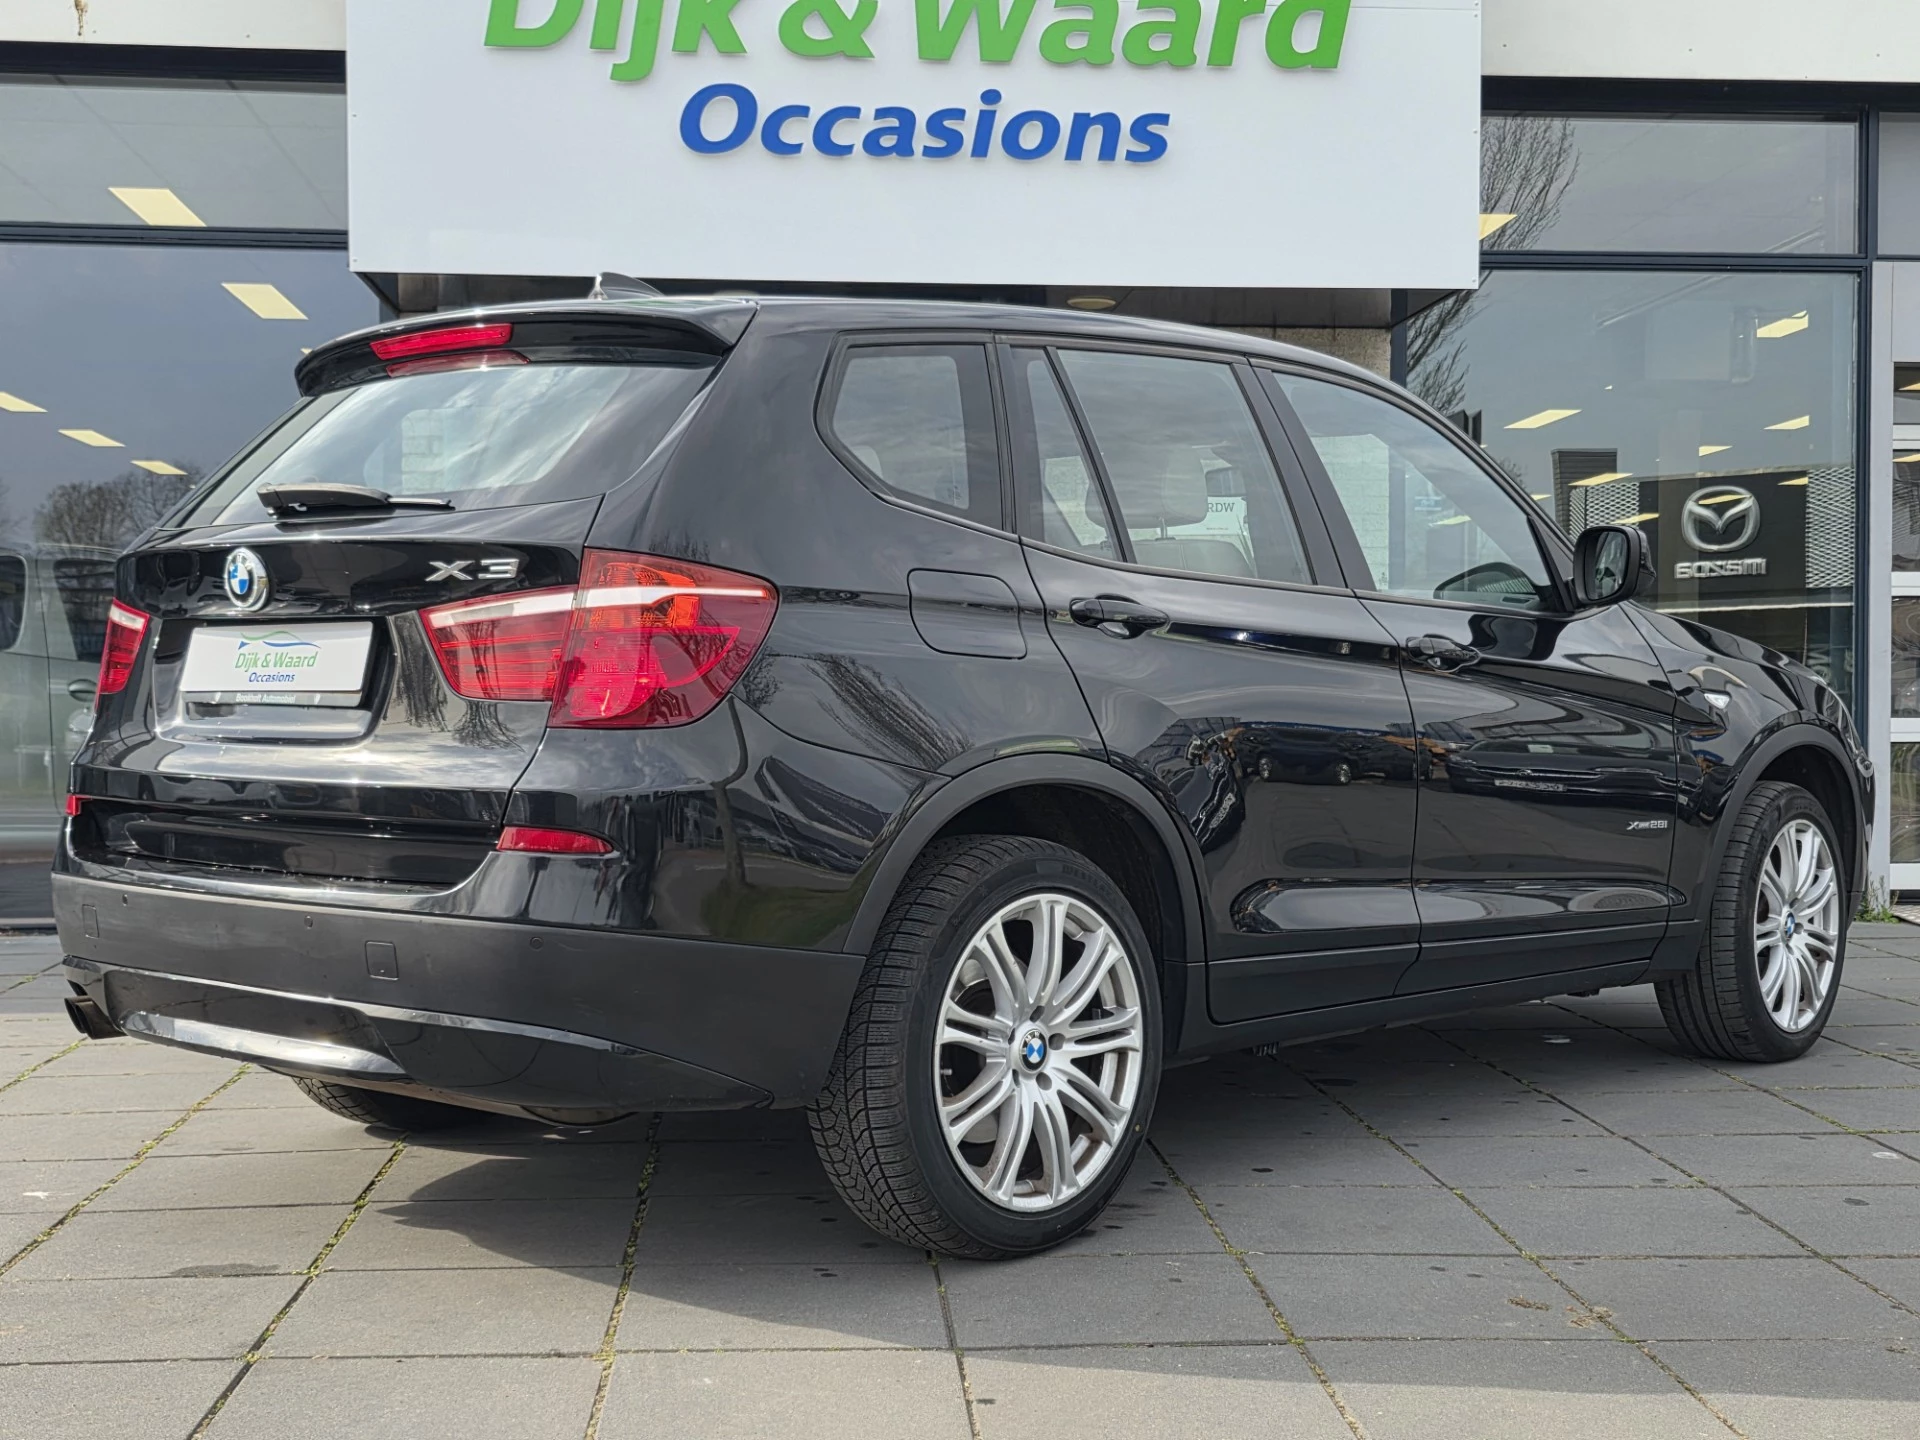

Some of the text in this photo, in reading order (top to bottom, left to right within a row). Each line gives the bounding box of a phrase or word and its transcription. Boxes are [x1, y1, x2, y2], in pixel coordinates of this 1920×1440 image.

[778, 0, 879, 59] &
[914, 0, 1352, 69] Waard
[679, 83, 1171, 162] Occasions
[1207, 502, 1235, 513] RDW
[425, 559, 520, 581] X3
[235, 651, 318, 672] Dijk & Waard
[248, 671, 296, 683] Occasions
